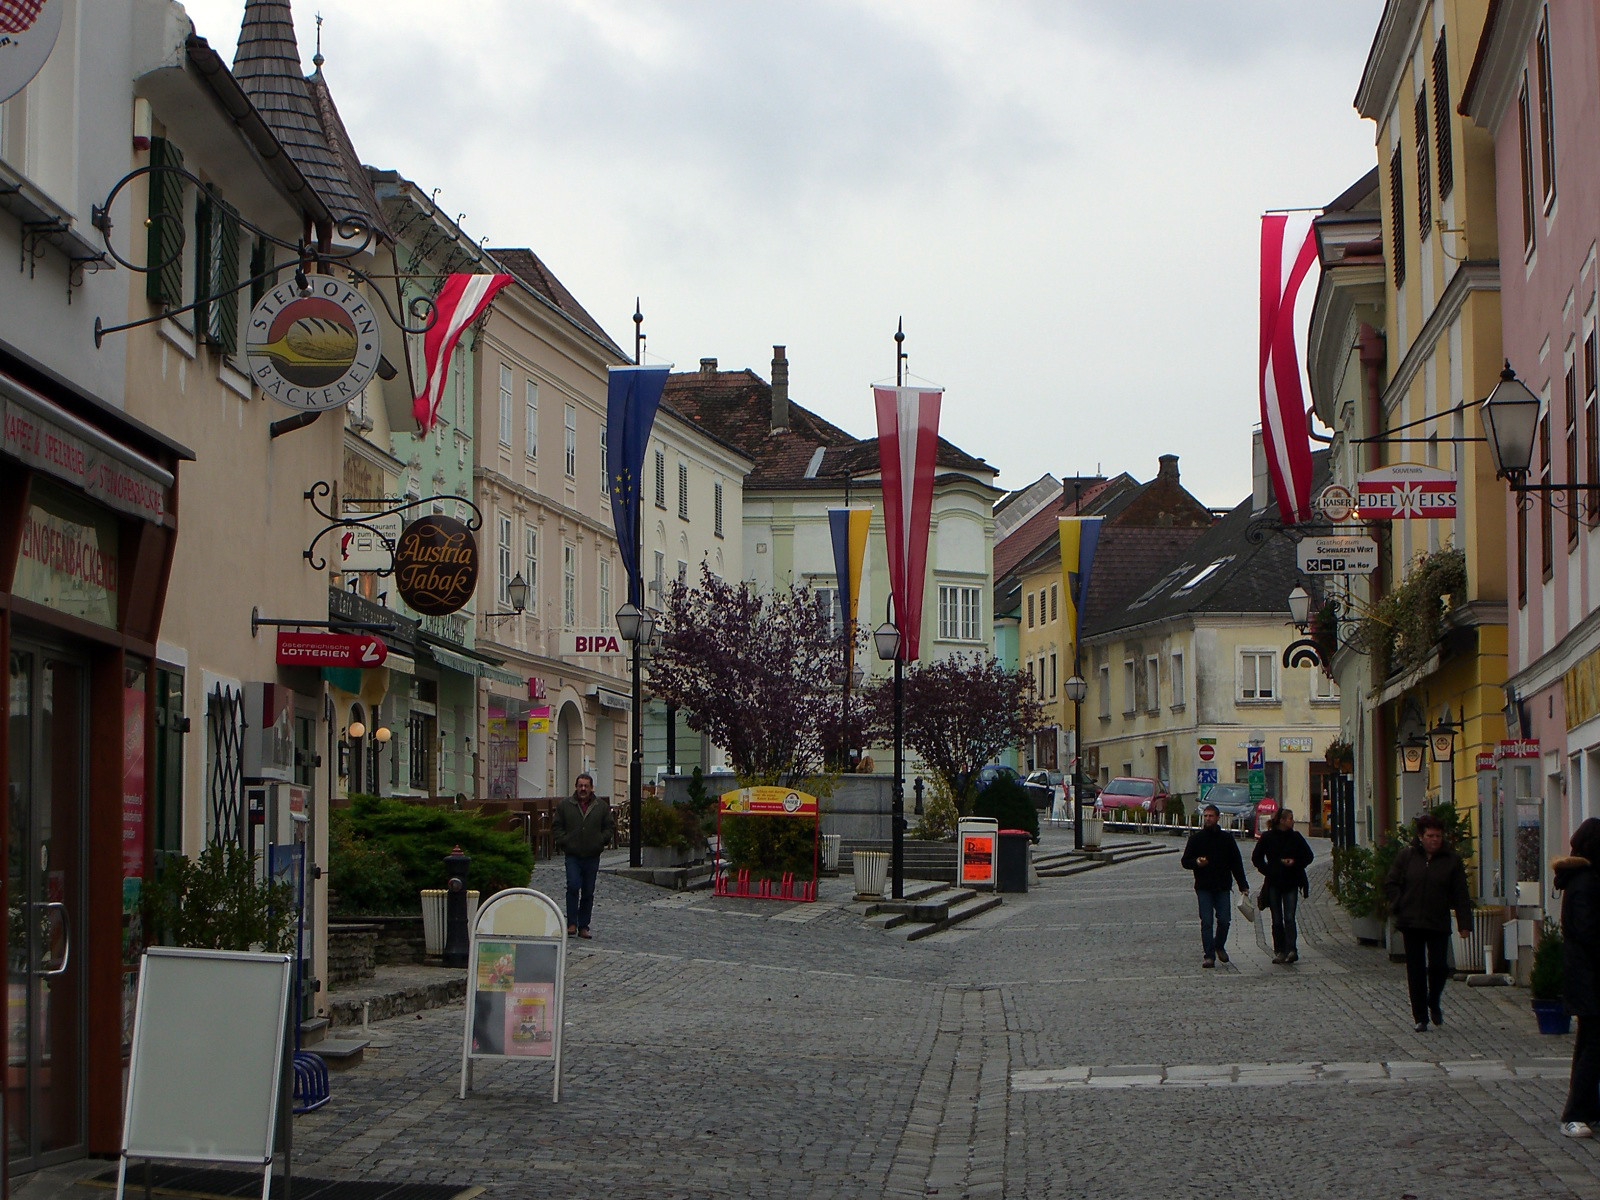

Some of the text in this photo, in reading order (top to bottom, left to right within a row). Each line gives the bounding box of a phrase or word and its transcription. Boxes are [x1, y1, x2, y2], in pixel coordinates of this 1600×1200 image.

[257, 362, 370, 405] BÄCKEREI
[3, 411, 33, 451] KAFFEE
[1391, 466, 1423, 475] SOUVENIRS
[1323, 498, 1352, 507] KAISER
[1358, 493, 1457, 507] EDELWEISS
[398, 528, 473, 565] Austria
[1316, 539, 1343, 547] Gasthof
[1317, 546, 1374, 554] SCHWARZEN WIRT
[401, 564, 473, 596] Tabak
[282, 641, 350, 651] österreichische
[575, 636, 620, 653] BIPA
[282, 648, 350, 658] LOTTERIEN
